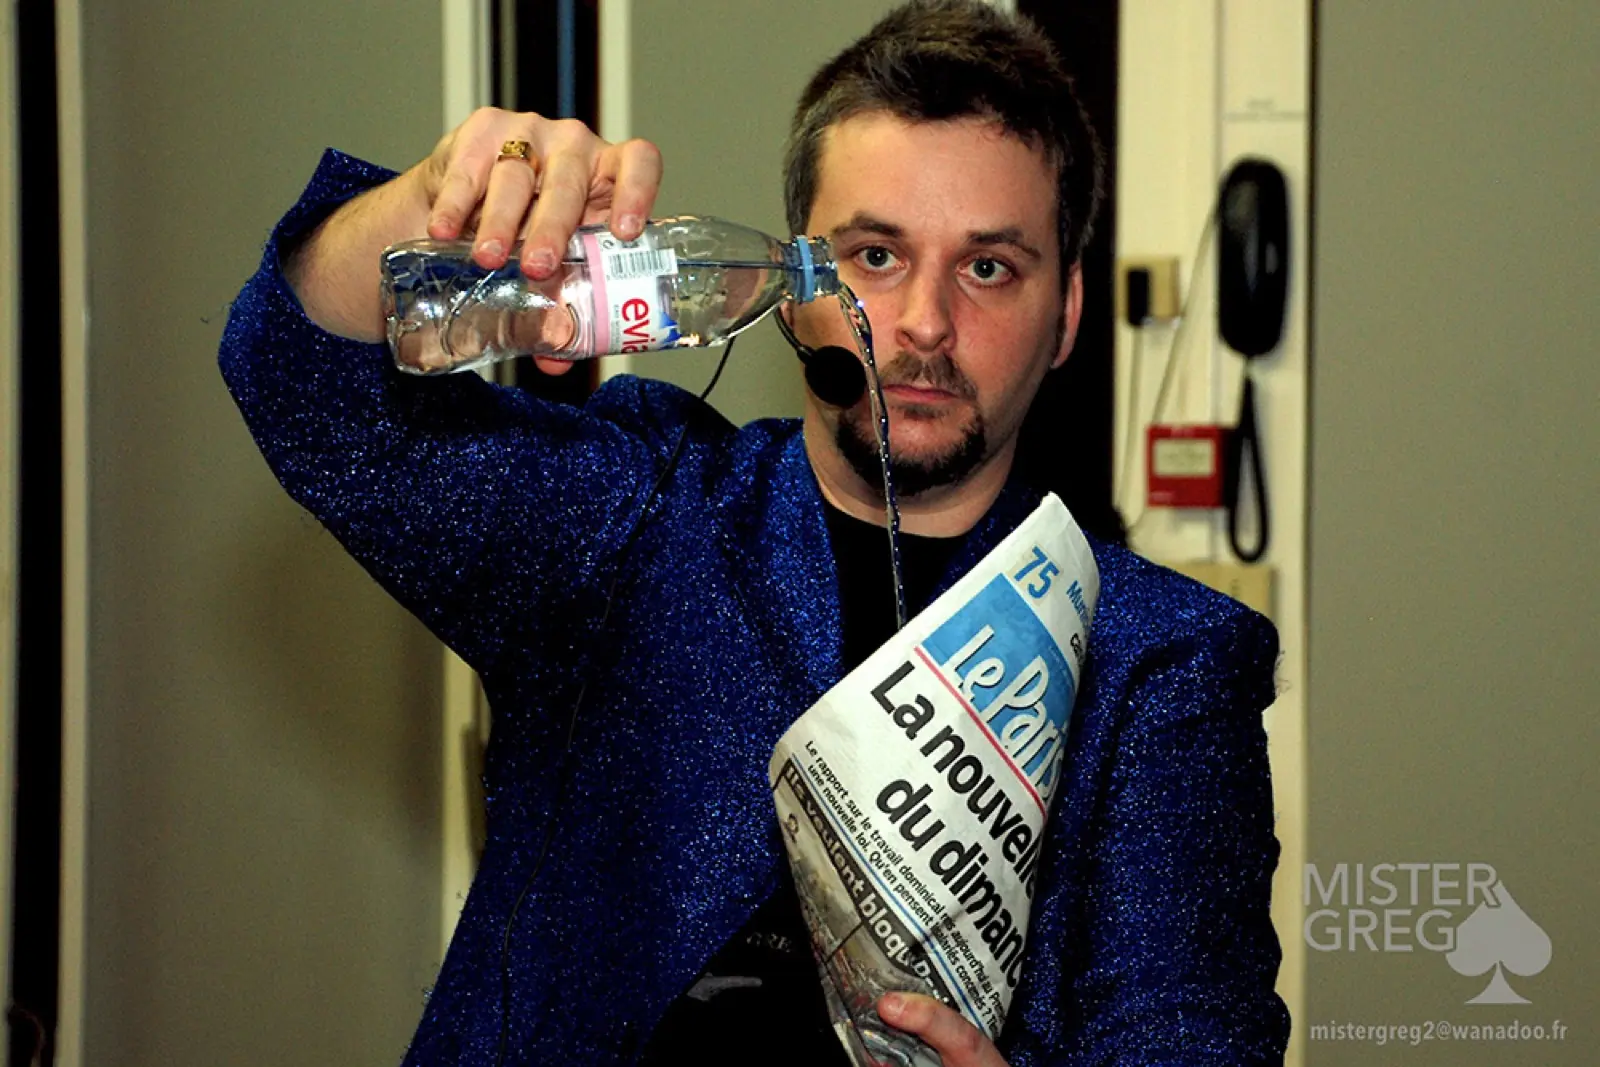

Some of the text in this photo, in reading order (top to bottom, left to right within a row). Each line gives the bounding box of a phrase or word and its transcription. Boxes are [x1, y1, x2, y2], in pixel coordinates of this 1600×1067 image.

[1013, 544, 1060, 599] 75
[870, 660, 935, 741] La
[940, 624, 1005, 702] Le
[805, 740, 818, 757] Le
[816, 755, 849, 800] rapport
[845, 799, 864, 819] sur
[860, 816, 873, 831] le
[869, 829, 904, 867] travail
[898, 864, 945, 915] dominical
[806, 801, 864, 898] veulent
[807, 764, 825, 787] une
[822, 787, 857, 834] nouvelle
[855, 832, 868, 852] loi.
[868, 850, 897, 885] Qu'en
[893, 882, 934, 927] pensent
[876, 779, 946, 852] du
